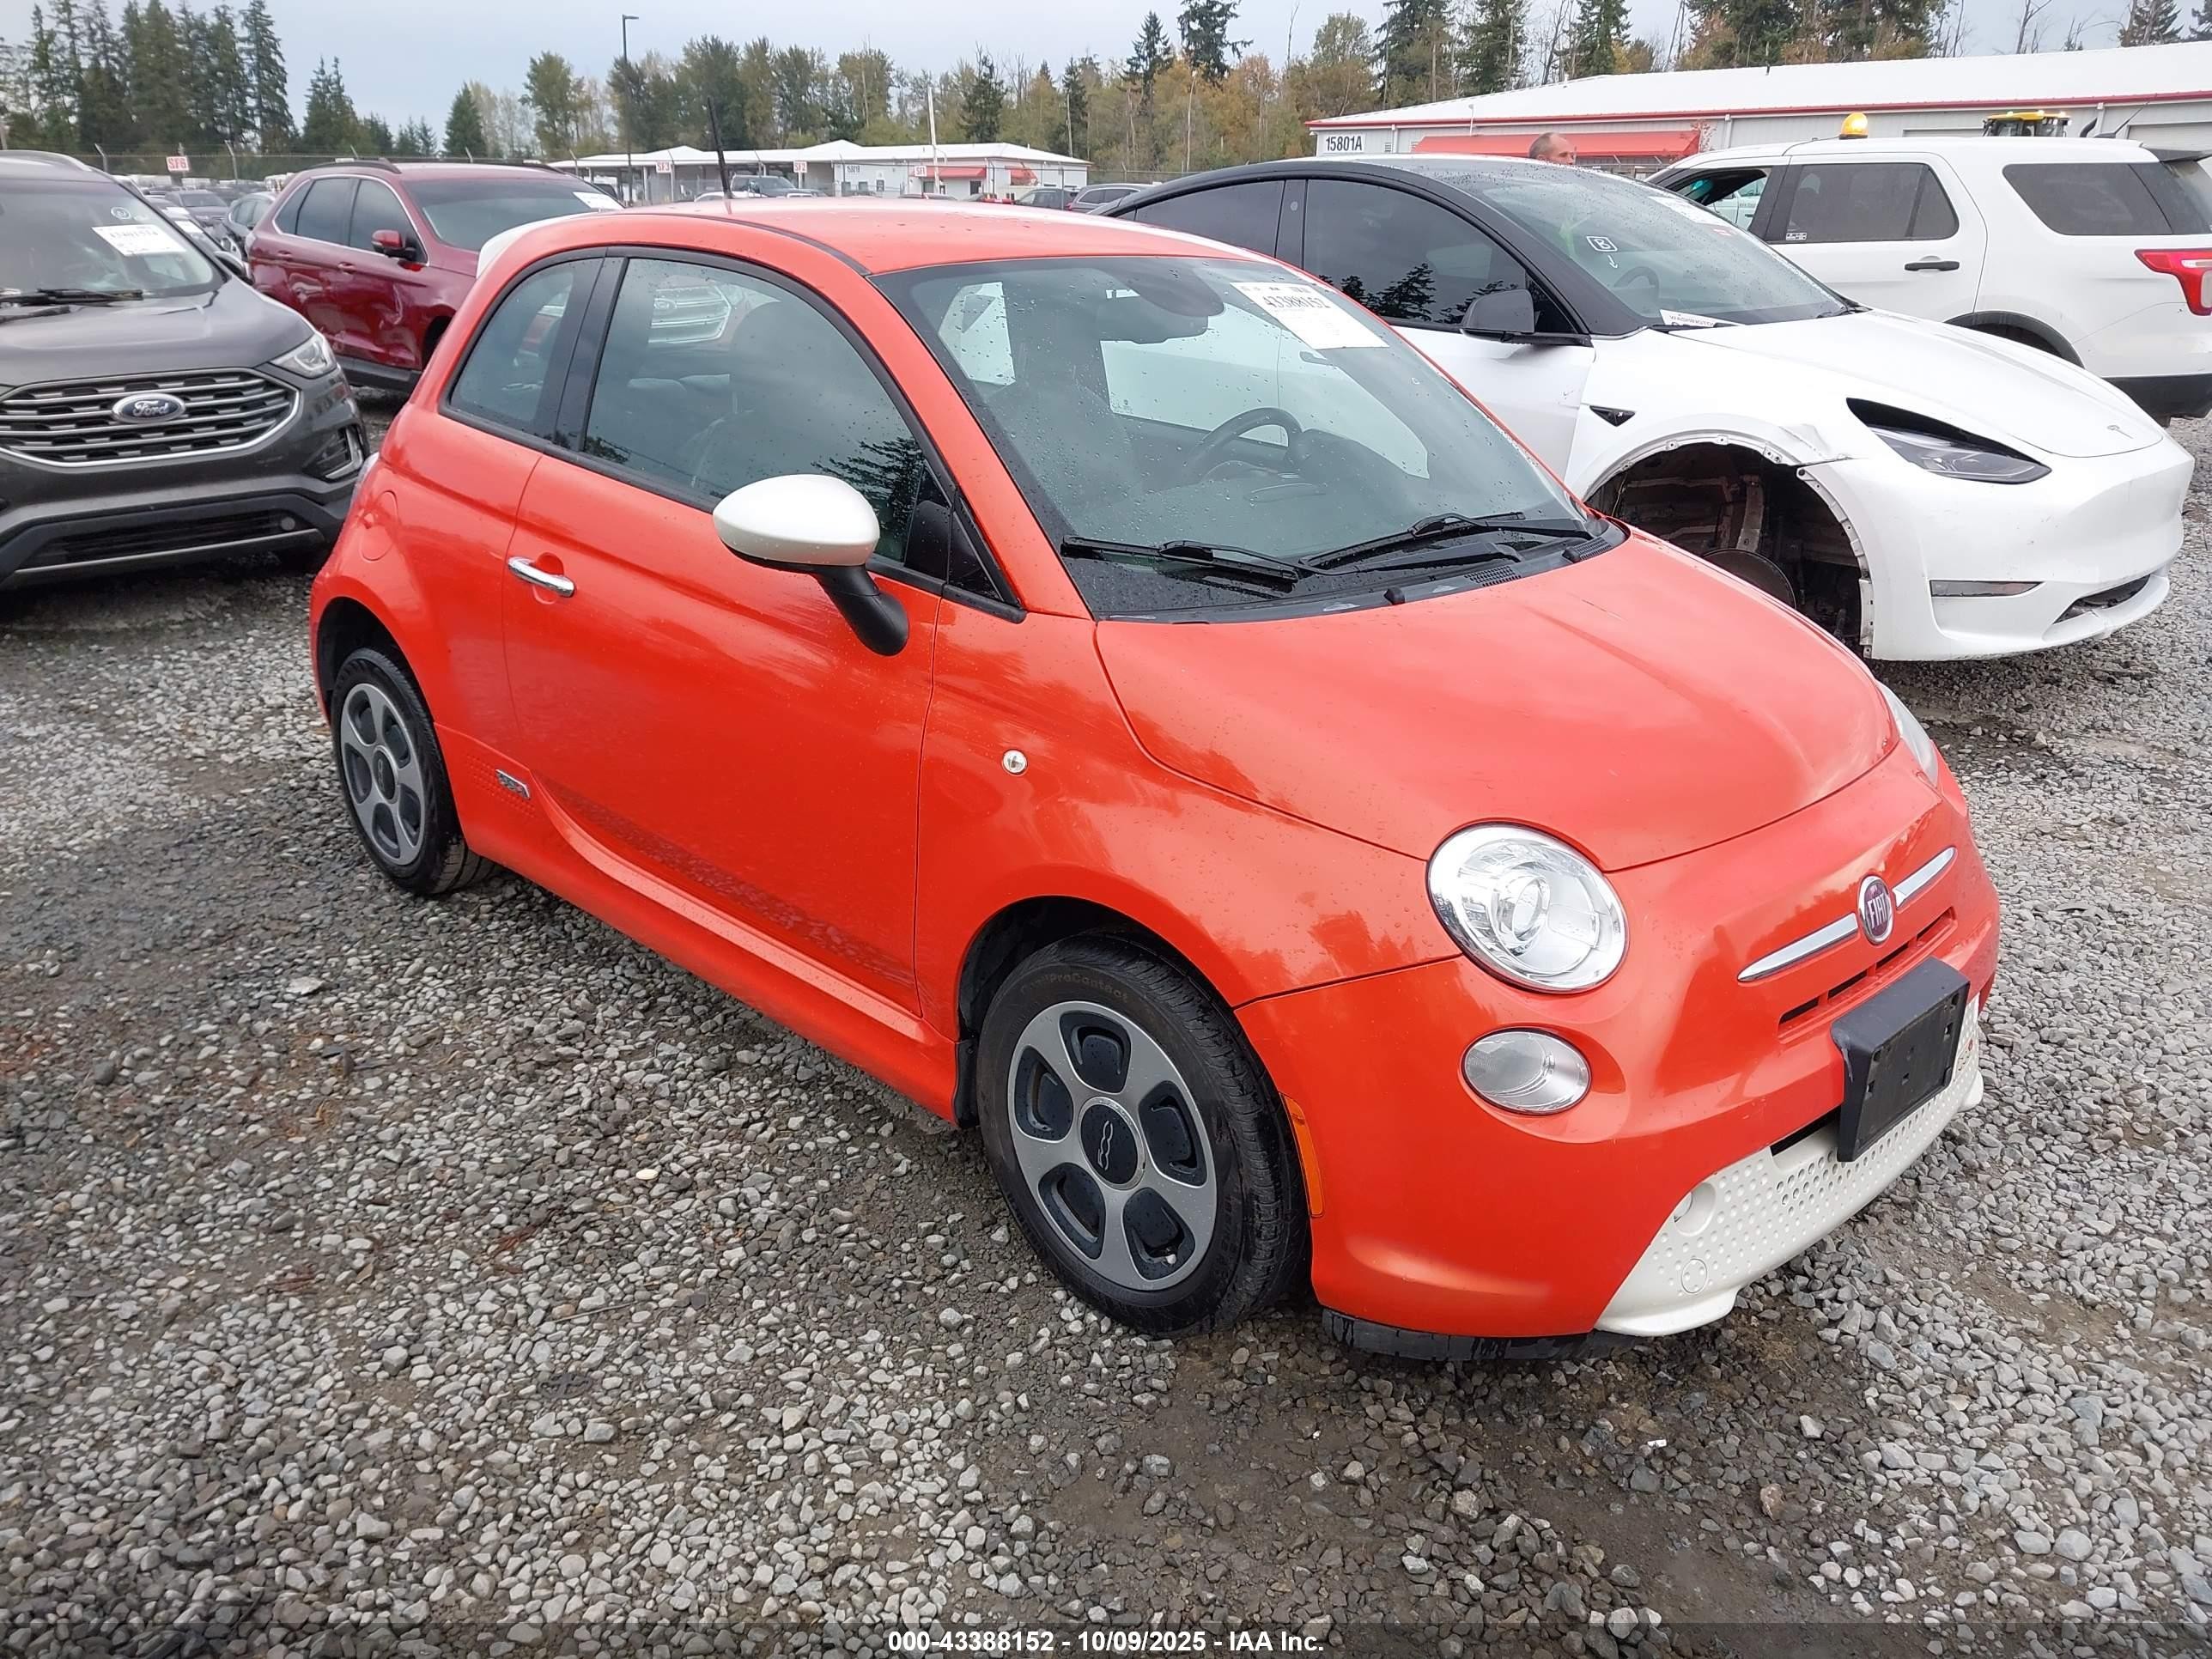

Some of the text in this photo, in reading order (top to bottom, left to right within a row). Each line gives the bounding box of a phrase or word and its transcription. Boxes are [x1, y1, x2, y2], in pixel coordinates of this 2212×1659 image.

[1325, 136, 1363, 151] 15801A
[167, 157, 187, 169] SF6
[794, 162, 805, 172] SF2
[915, 167, 926, 175] SF1
[132, 400, 169, 416] Ford
[1866, 892, 1891, 929] FIAT
